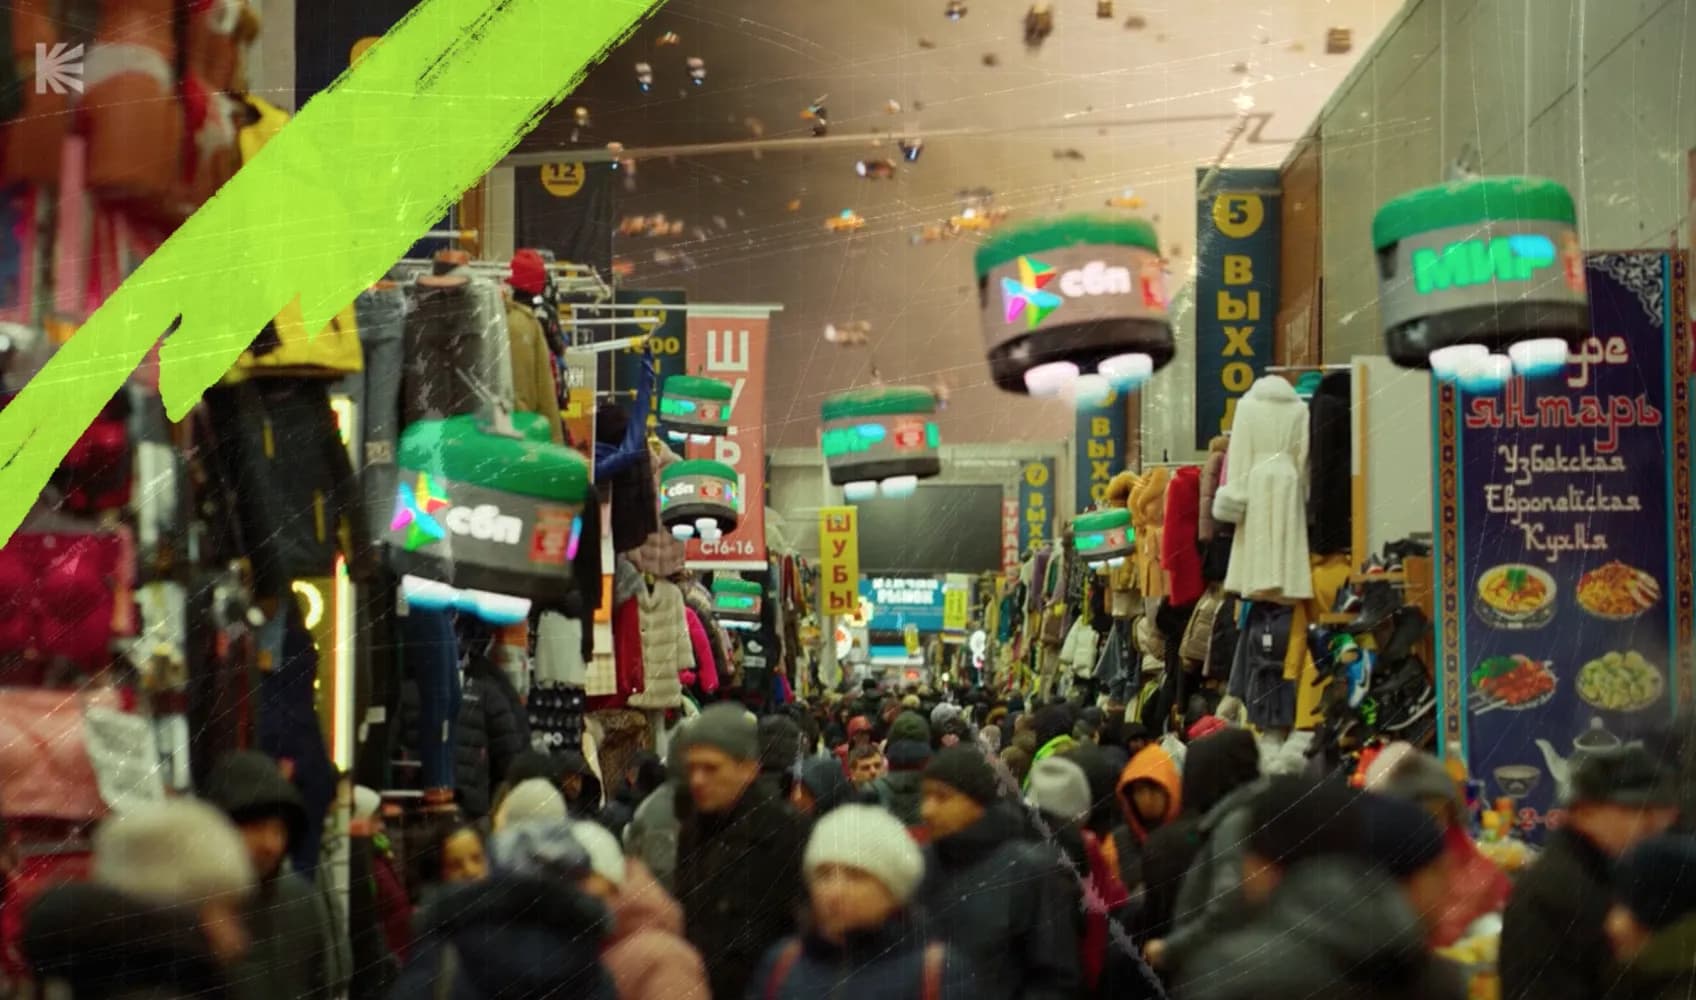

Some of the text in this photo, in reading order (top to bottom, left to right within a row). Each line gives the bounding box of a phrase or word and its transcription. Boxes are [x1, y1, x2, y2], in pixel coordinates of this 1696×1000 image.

[549, 161, 577, 178] 12
[1228, 200, 1249, 226] 5
[1412, 234, 1556, 294] МИР
[826, 513, 852, 609] ШУБЫ
